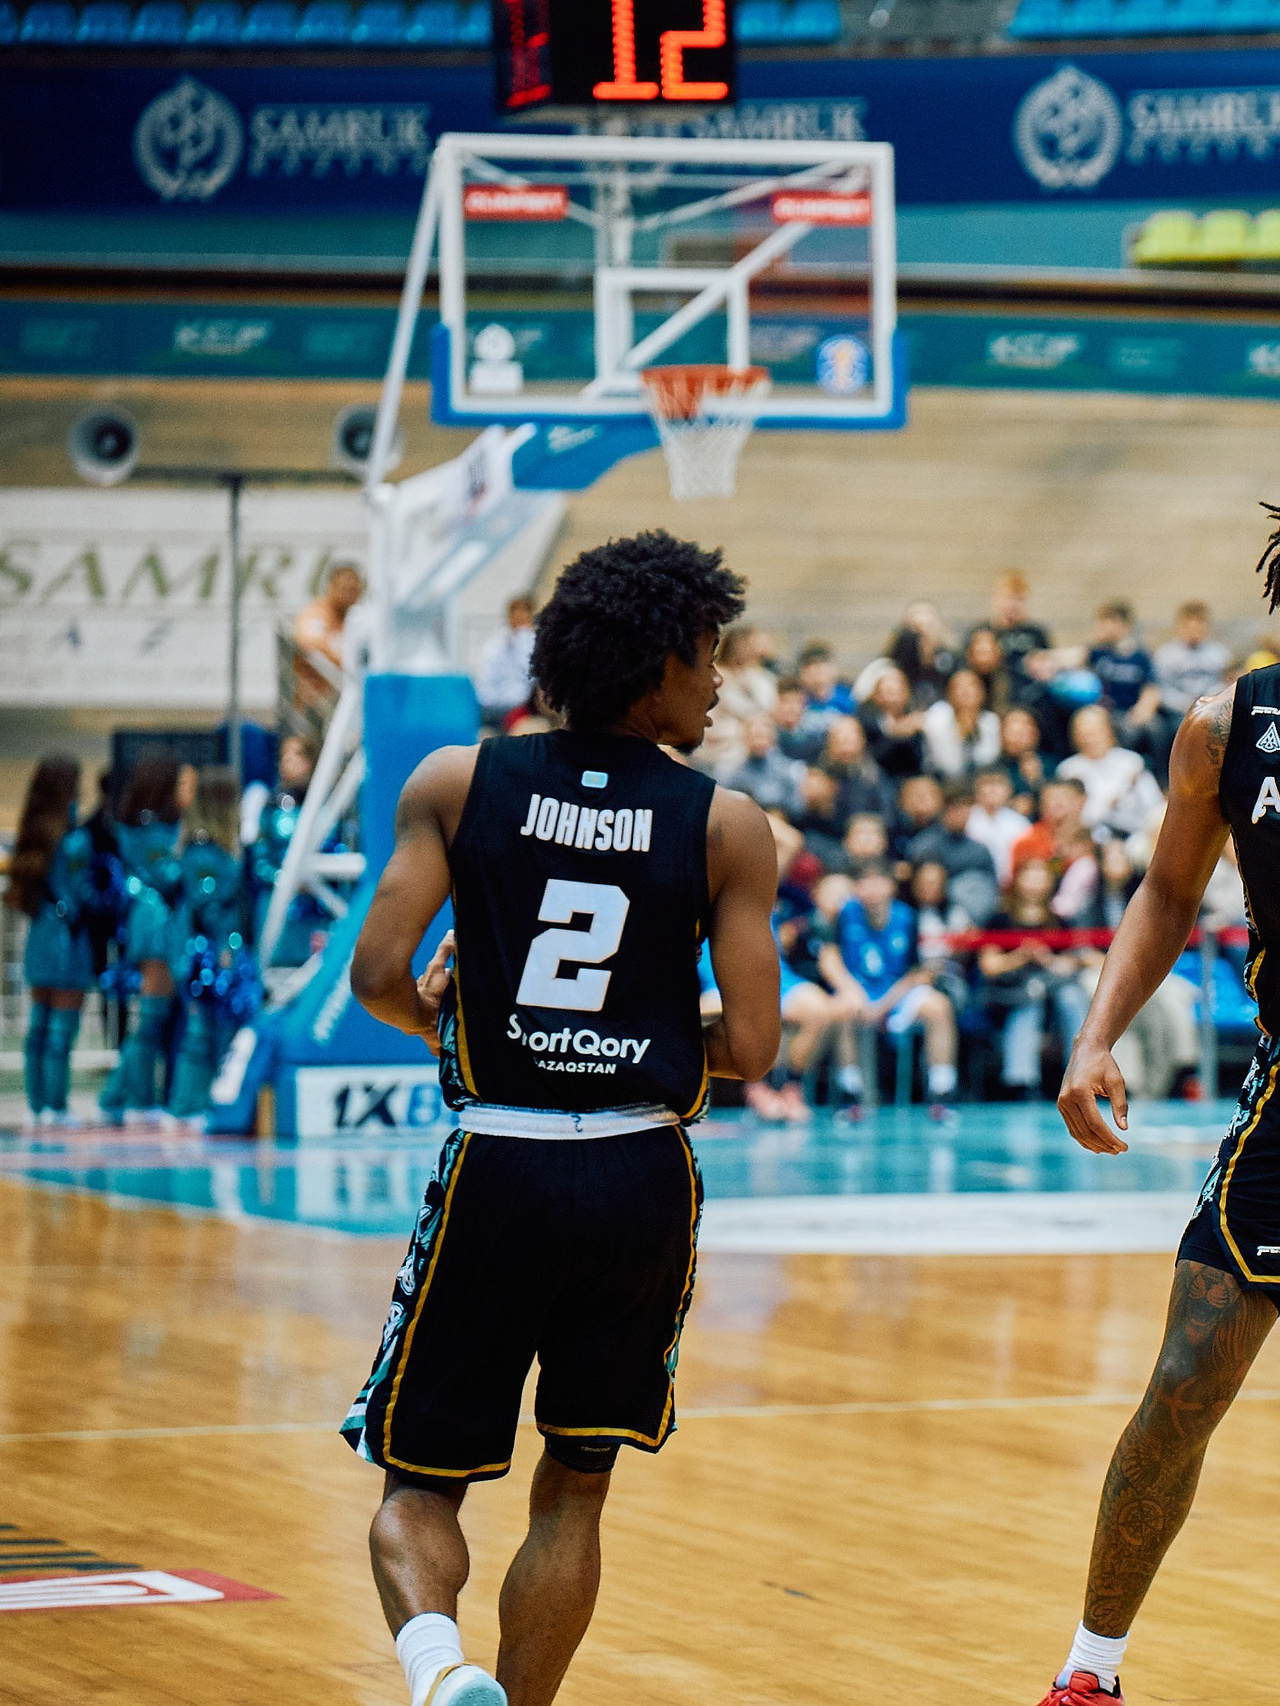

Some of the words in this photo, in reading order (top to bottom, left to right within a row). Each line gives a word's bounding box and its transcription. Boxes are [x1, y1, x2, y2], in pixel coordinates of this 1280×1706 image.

[592, 0, 729, 100] 12
[520, 793, 653, 852] JOHNSON
[516, 878, 630, 1012] 2
[507, 1013, 651, 1065] SortQory
[534, 1058, 617, 1075] AZAQSTAN
[334, 1082, 459, 1128] 1XB
